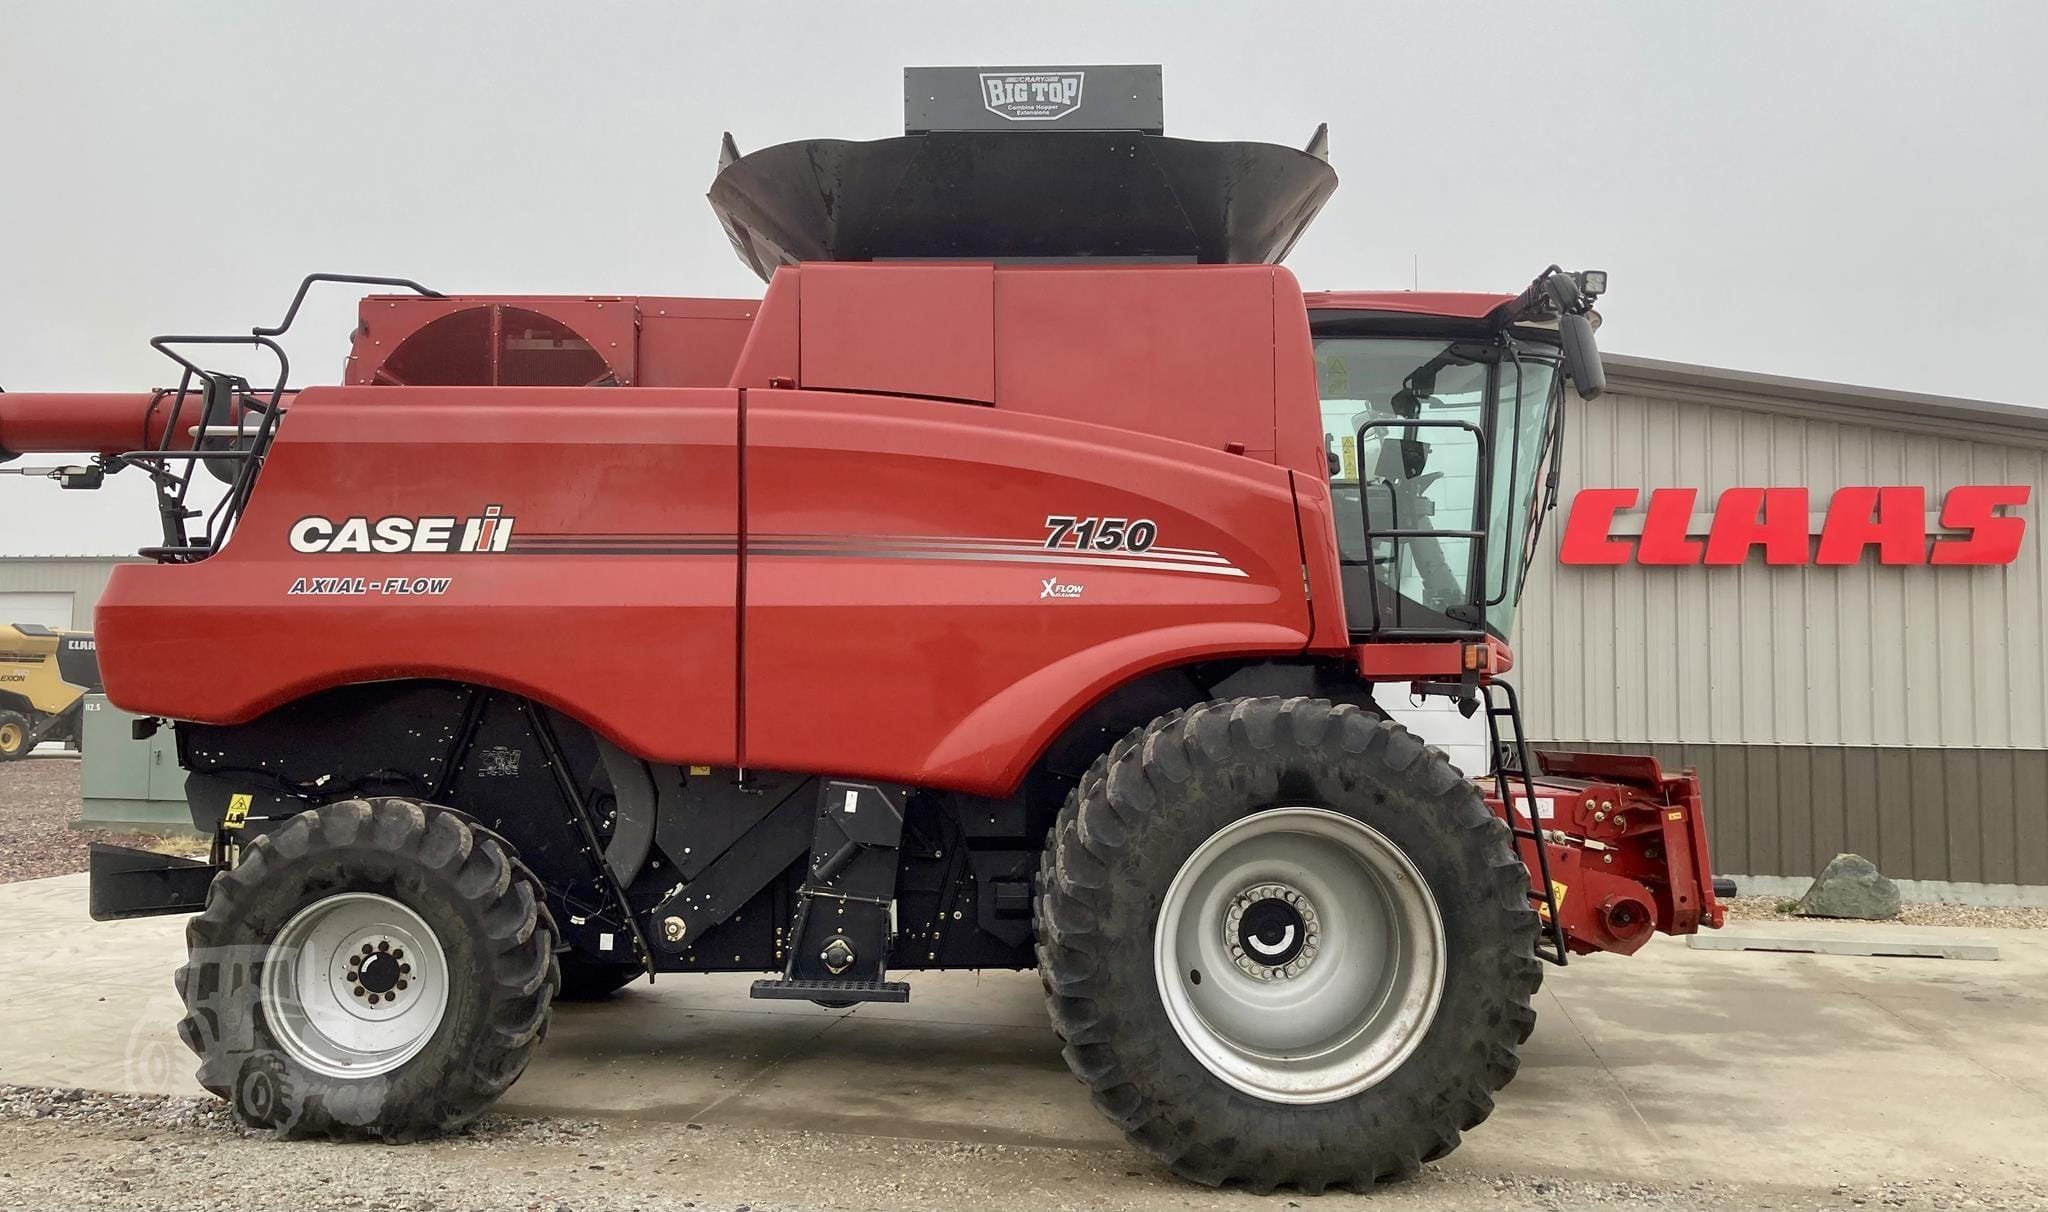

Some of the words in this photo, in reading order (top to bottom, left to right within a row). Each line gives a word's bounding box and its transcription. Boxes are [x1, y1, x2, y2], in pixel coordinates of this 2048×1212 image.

[987, 79, 1028, 107] BIG
[1031, 78, 1078, 105] TOP
[288, 515, 456, 554] CASE
[1043, 515, 1158, 554] 7150
[1559, 485, 2032, 566] CLAAS
[288, 577, 452, 595] AXIAL-FLOW
[1055, 584, 1084, 593] FLOW
[68, 640, 97, 650] CLAA
